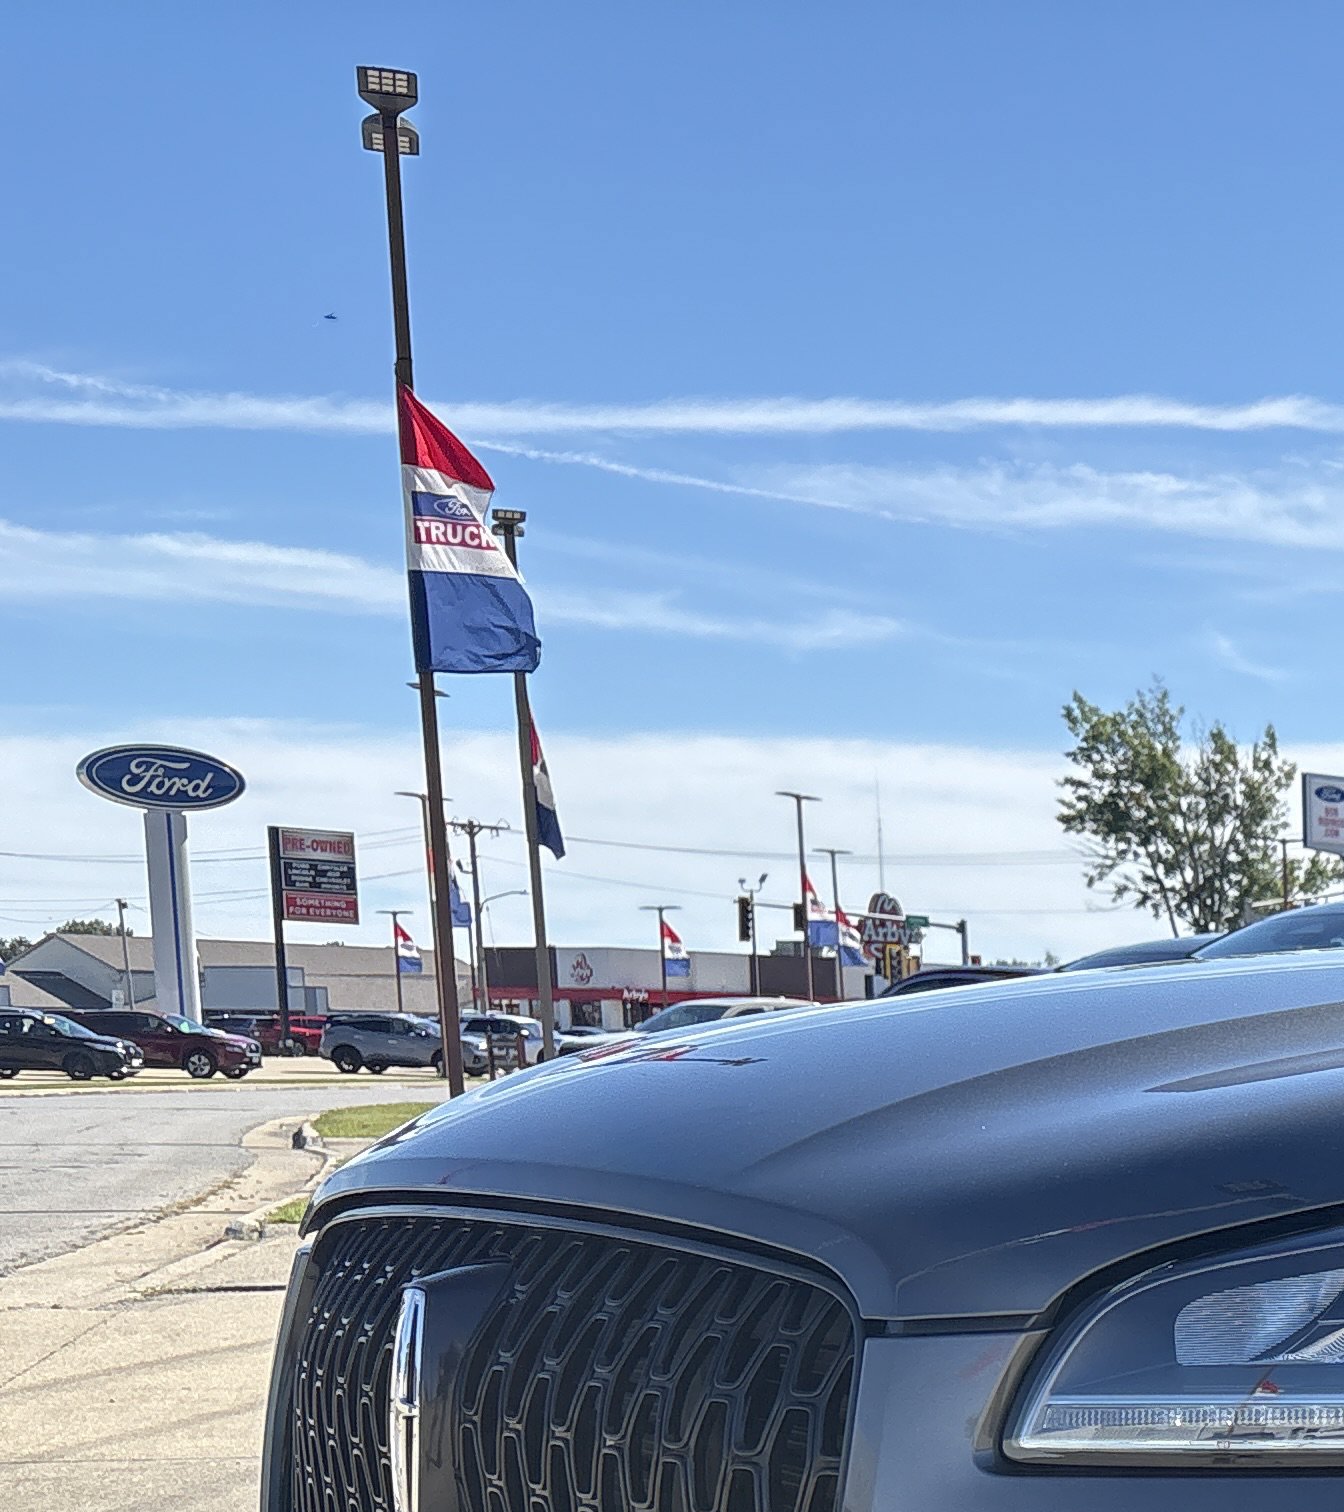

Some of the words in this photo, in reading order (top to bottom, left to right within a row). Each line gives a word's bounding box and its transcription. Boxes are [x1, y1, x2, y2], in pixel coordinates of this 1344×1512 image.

[445, 500, 471, 516] For
[416, 520, 496, 548] TRUCK
[121, 757, 215, 799] Ford
[282, 836, 353, 855] PRE-OWNED
[288, 905, 308, 915] FOR
[309, 906, 355, 918] EVERYONE
[295, 897, 347, 909] SOMETHING
